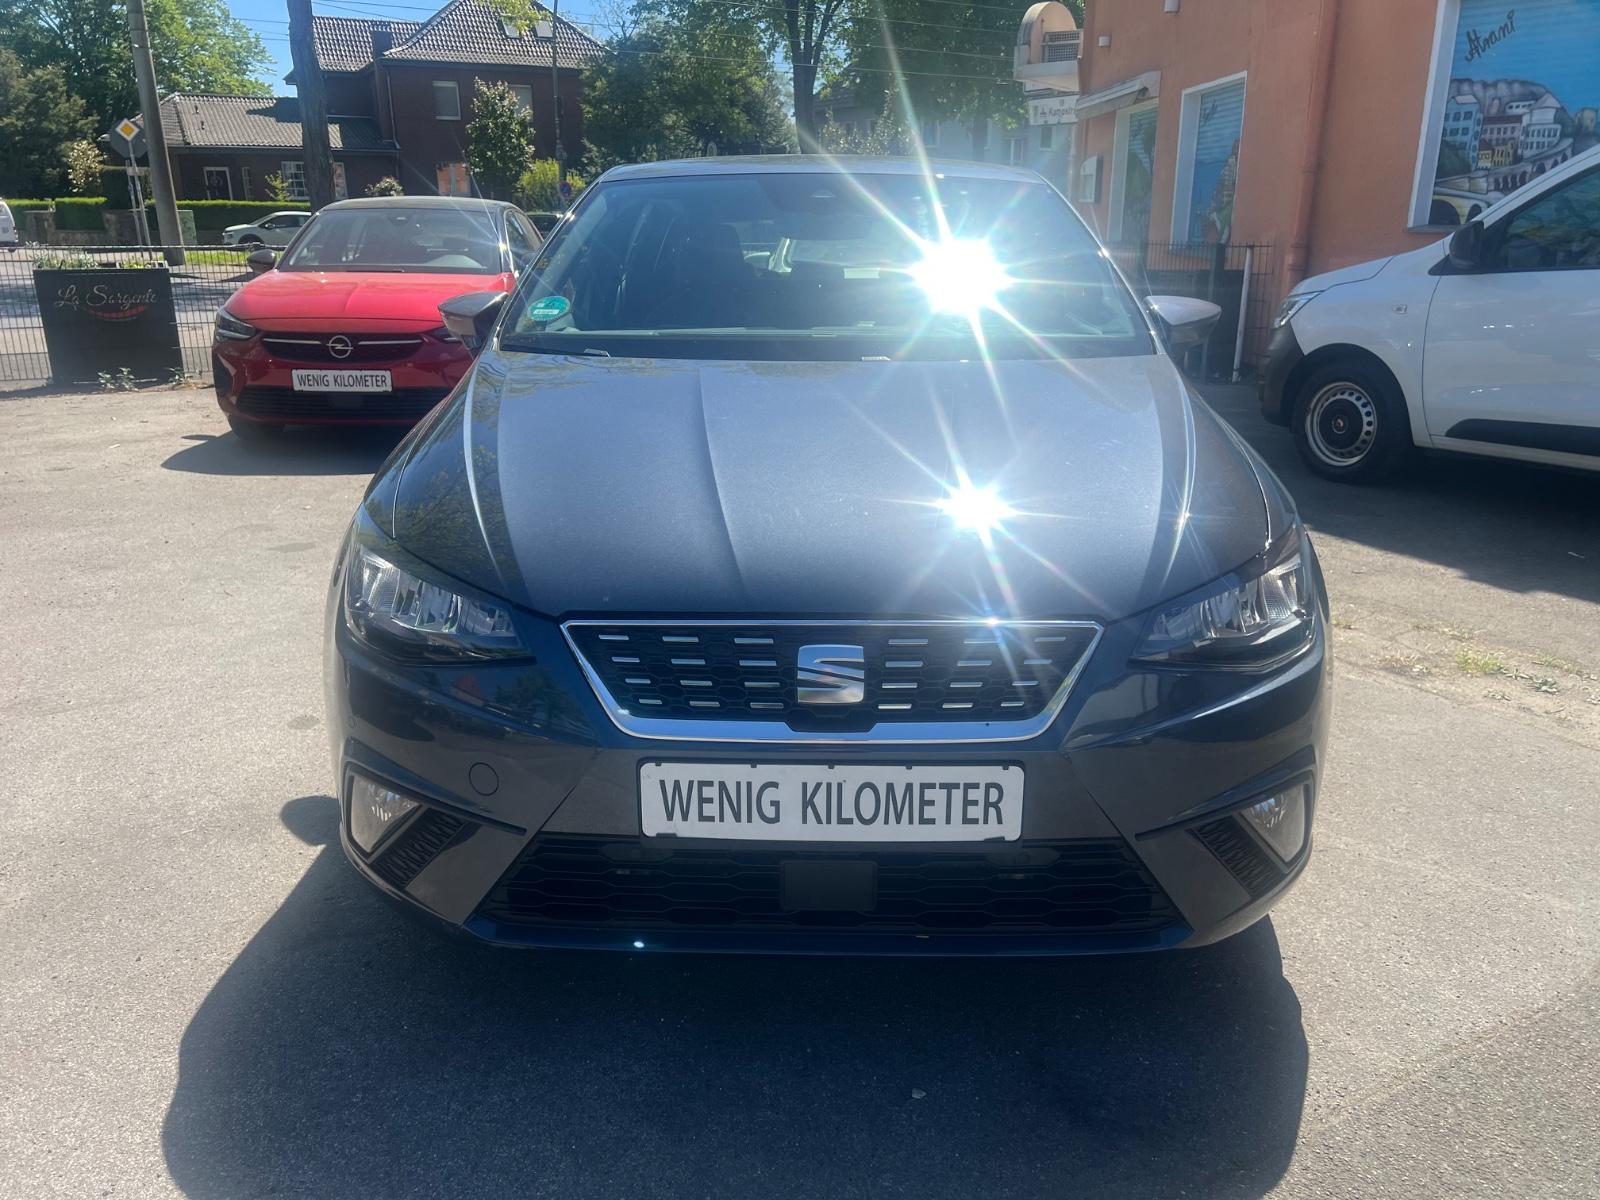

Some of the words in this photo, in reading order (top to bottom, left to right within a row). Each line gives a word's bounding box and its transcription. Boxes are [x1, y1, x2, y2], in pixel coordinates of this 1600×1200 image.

[297, 374, 330, 387] WENIG
[333, 374, 387, 388] KILOMETER
[659, 779, 781, 824] WENIG
[801, 781, 1005, 826] KILOMETER
